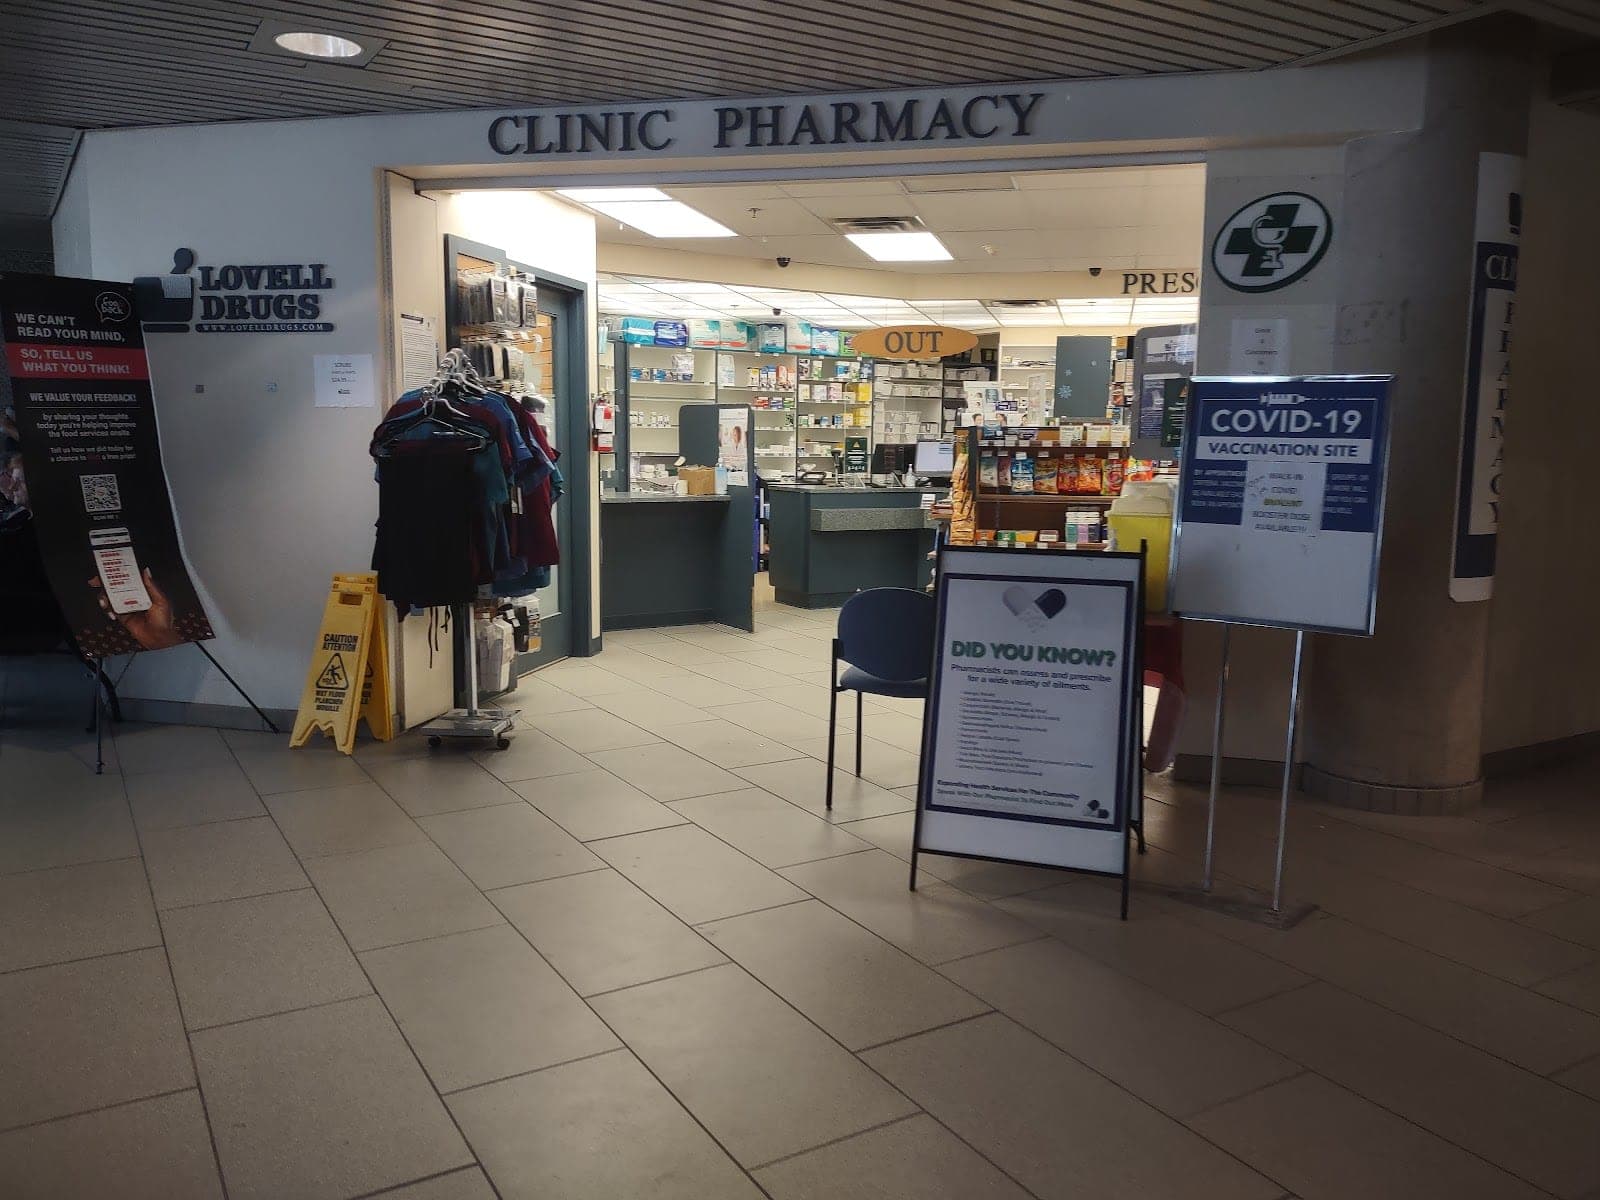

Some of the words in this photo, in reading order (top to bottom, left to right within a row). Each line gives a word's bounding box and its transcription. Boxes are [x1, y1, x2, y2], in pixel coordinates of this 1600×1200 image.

[488, 108, 674, 155] CLINIC
[713, 93, 1045, 149] PHARMACY
[198, 264, 333, 290] LOVELL
[1122, 272, 1199, 295] PRES
[200, 294, 320, 320] DRUGS
[15, 313, 36, 323] WE
[38, 314, 76, 326] CAN'T
[202, 323, 324, 332] WWW.LOVELLDRUGS.COM
[17, 326, 52, 338] READ
[54, 328, 88, 340] YOUR
[90, 330, 125, 342] MIND,
[884, 331, 944, 354] OUT
[20, 348, 42, 360] SO,
[44, 349, 74, 360] TELL
[77, 351, 93, 361] US
[22, 361, 59, 373] WHAT
[61, 363, 87, 373] YOU
[89, 363, 130, 374] THINK!
[29, 392, 43, 401] WE
[44, 392, 70, 401] VALUE
[71, 393, 93, 401] YOUR
[94, 393, 137, 401] FEEDBACK!
[1211, 409, 1363, 434] COVID-19
[1209, 442, 1318, 457] VACCINATION
[1324, 444, 1359, 458] SITE
[323, 633, 359, 643] CAUTION
[952, 640, 986, 658] DID
[990, 643, 1034, 661] YOU
[1038, 646, 1116, 667] KNOW?
[951, 663, 1001, 675] Pharmacists
[1069, 672, 1112, 683] prescribe
